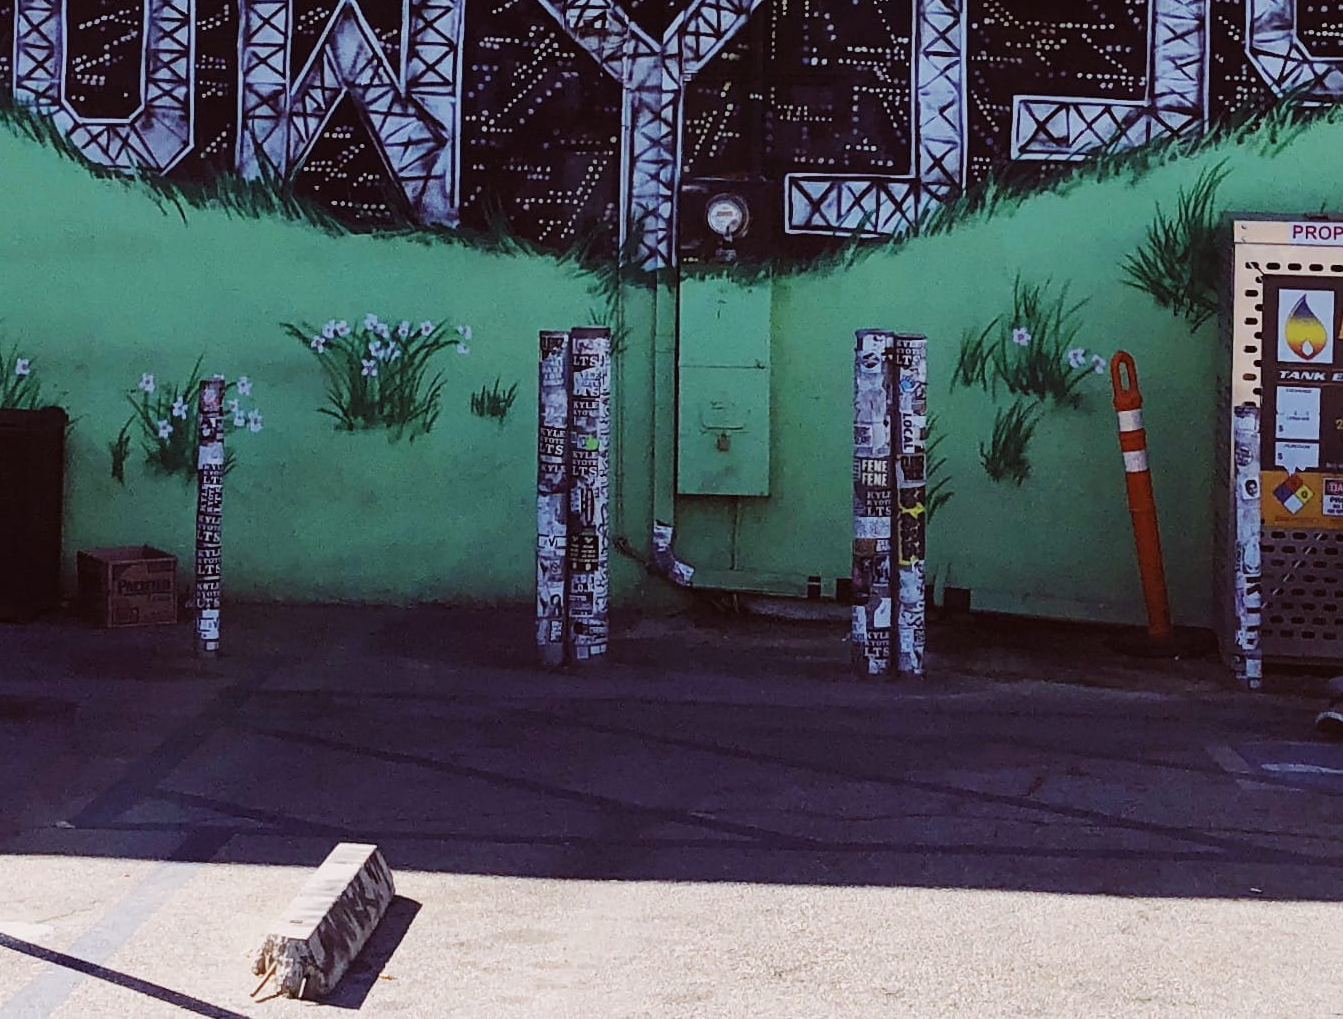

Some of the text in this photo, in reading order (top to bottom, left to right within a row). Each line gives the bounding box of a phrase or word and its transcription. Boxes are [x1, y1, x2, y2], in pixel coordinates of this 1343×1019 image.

[573, 355, 599, 366] LTS
[1279, 370, 1327, 382] TANK
[1335, 420, 1343, 430] 2
[903, 413, 914, 449] LOCAL
[573, 466, 598, 476] LTS
[861, 460, 888, 473] FENE
[203, 476, 223, 485] LT
[861, 473, 888, 486] FENE
[867, 506, 891, 517] LTS
[864, 647, 890, 657] LTS
